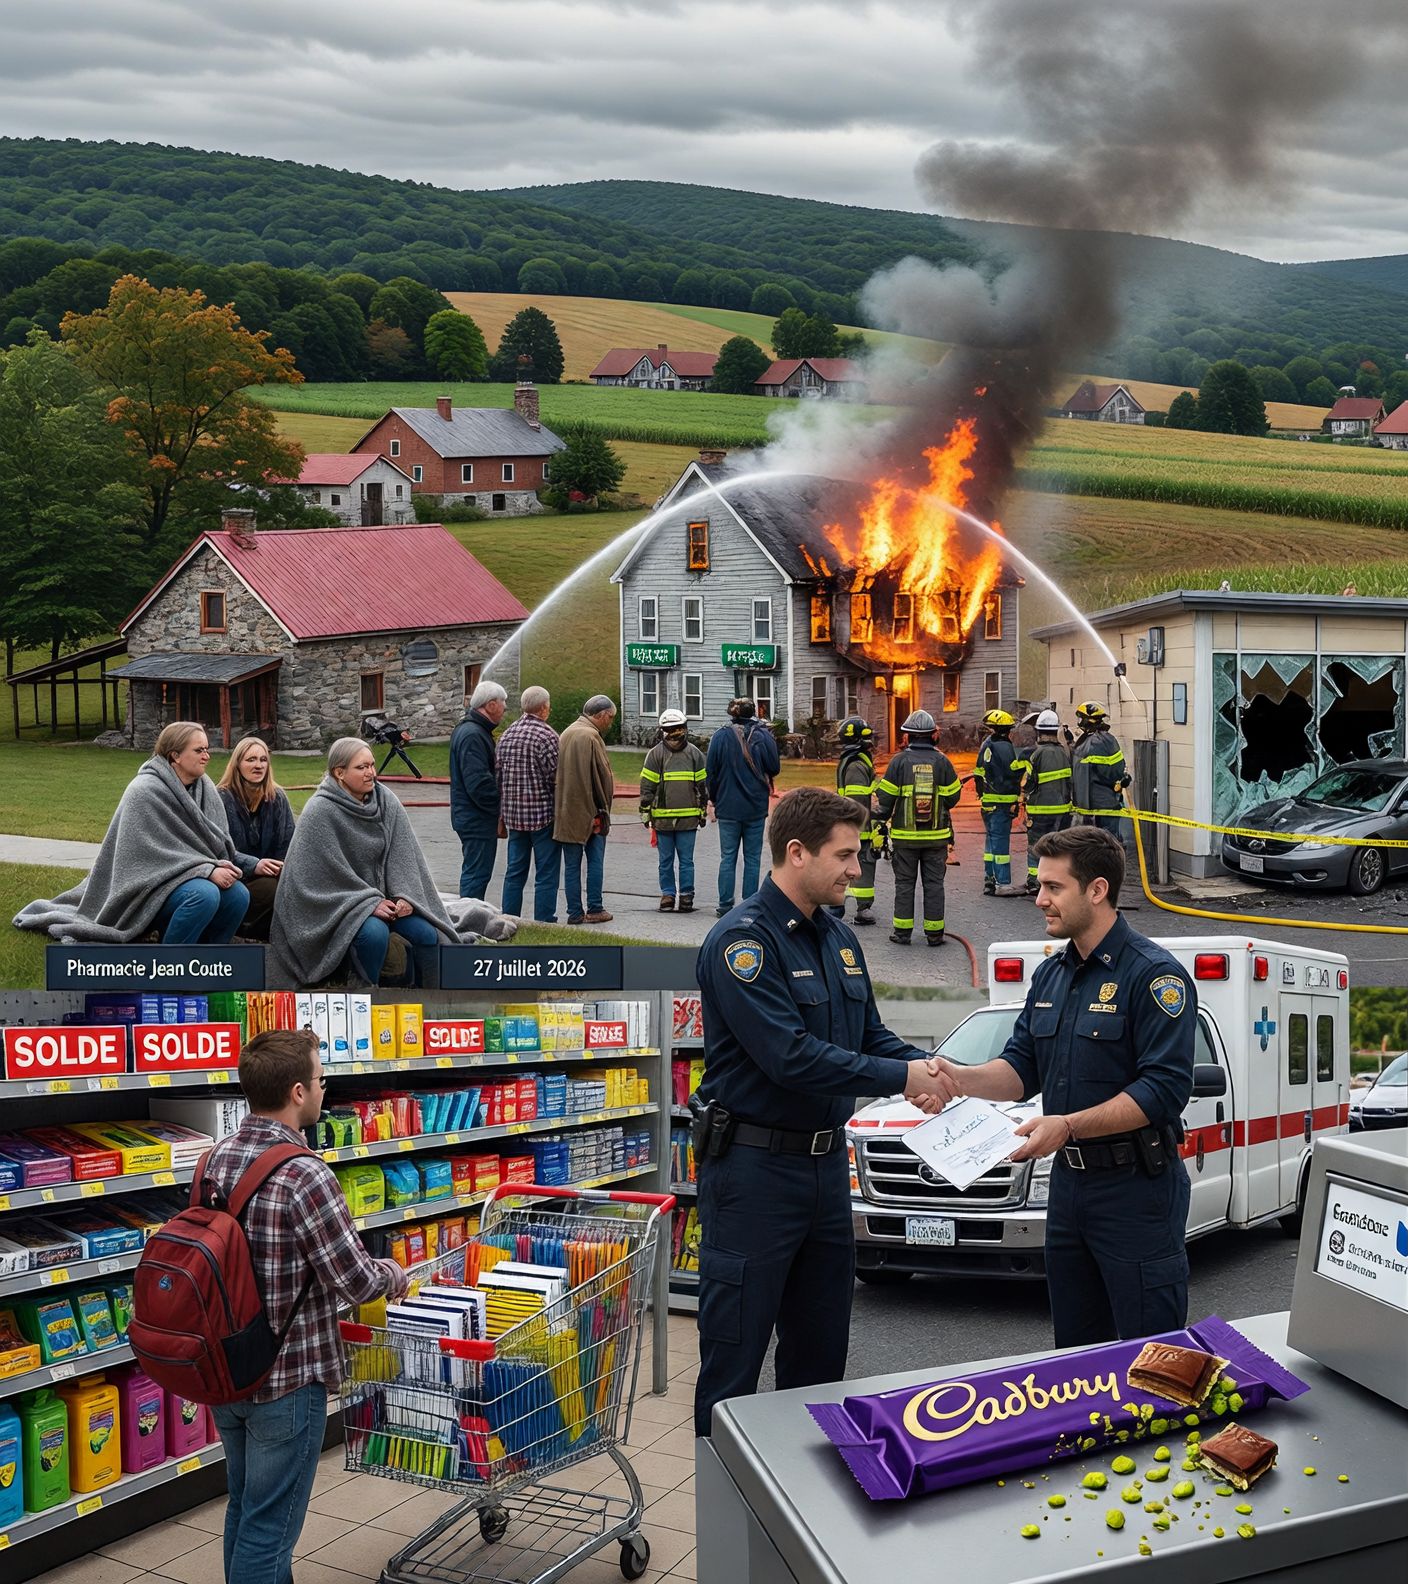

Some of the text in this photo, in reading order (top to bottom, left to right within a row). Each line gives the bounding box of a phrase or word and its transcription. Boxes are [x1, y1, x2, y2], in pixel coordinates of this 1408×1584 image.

[14, 1034, 118, 1068] SOLDE
[142, 1031, 232, 1062] SOLDE
[902, 1373, 1121, 1442] Cadbury
